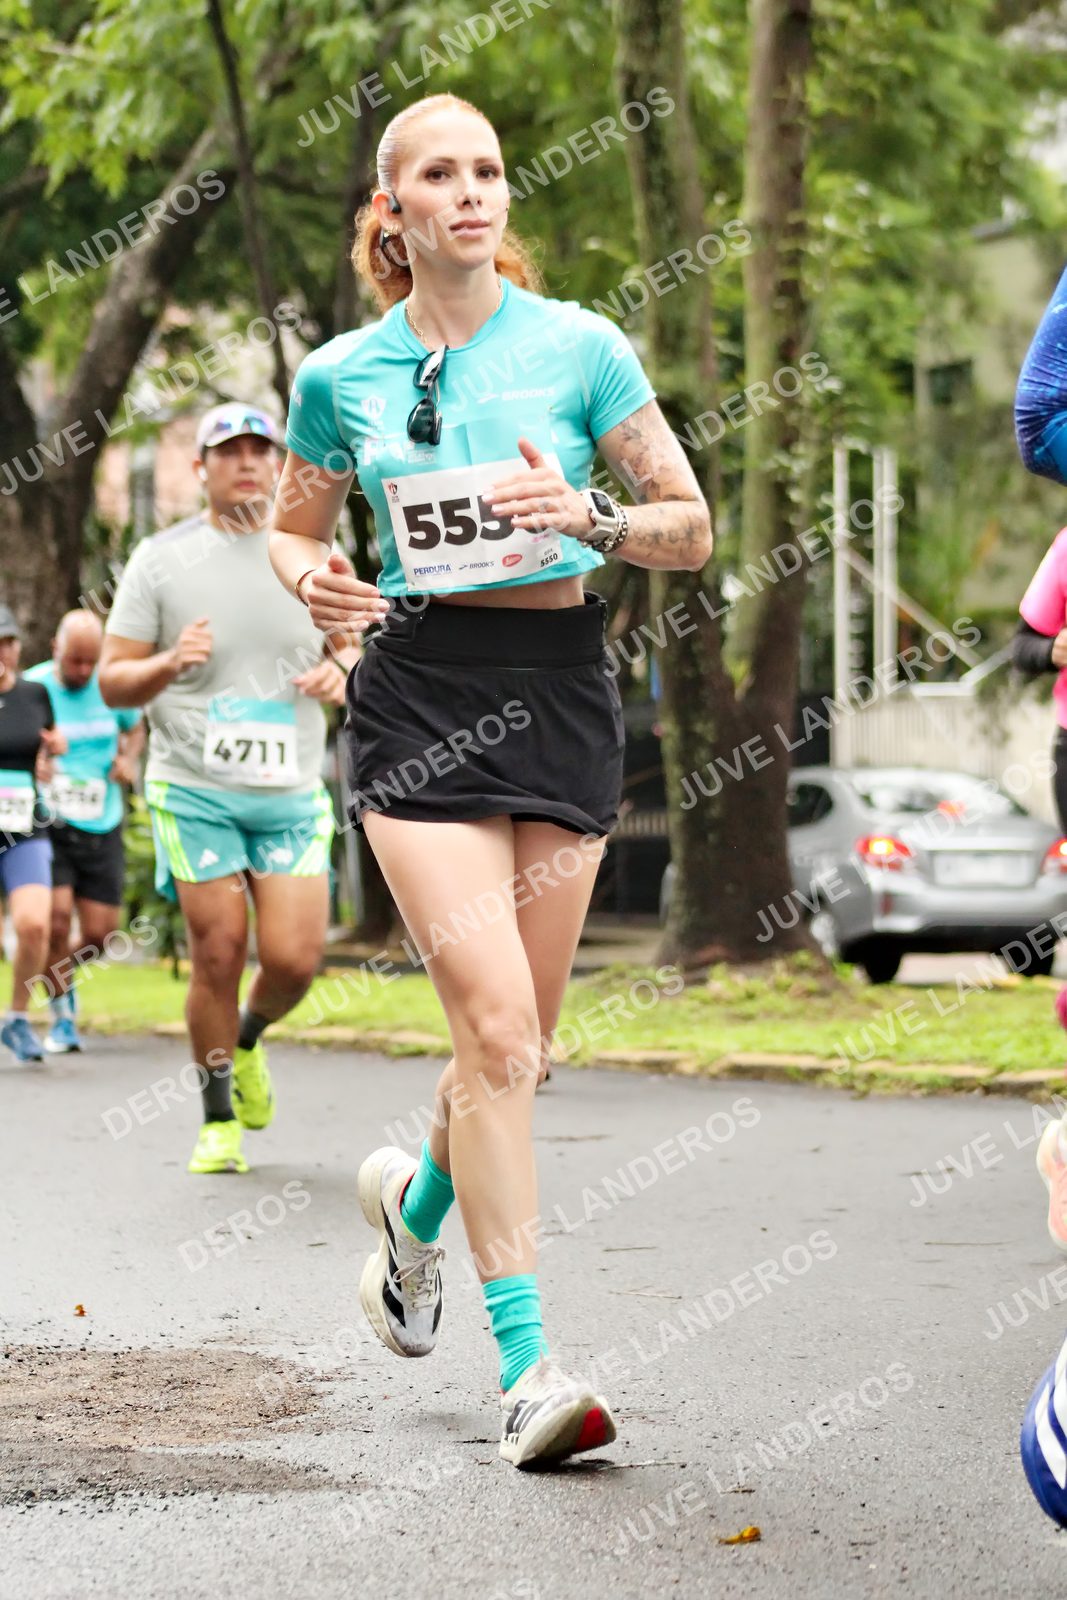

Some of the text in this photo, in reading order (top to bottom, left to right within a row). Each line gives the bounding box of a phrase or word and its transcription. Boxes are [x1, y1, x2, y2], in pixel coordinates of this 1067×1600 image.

[501, 386, 555, 400] BROOKS
[402, 494, 546, 551] 555
[469, 561, 494, 569] BROOKS
[540, 553, 558, 567] 5550
[413, 564, 452, 576] PERDURA
[213, 739, 285, 765] 4711
